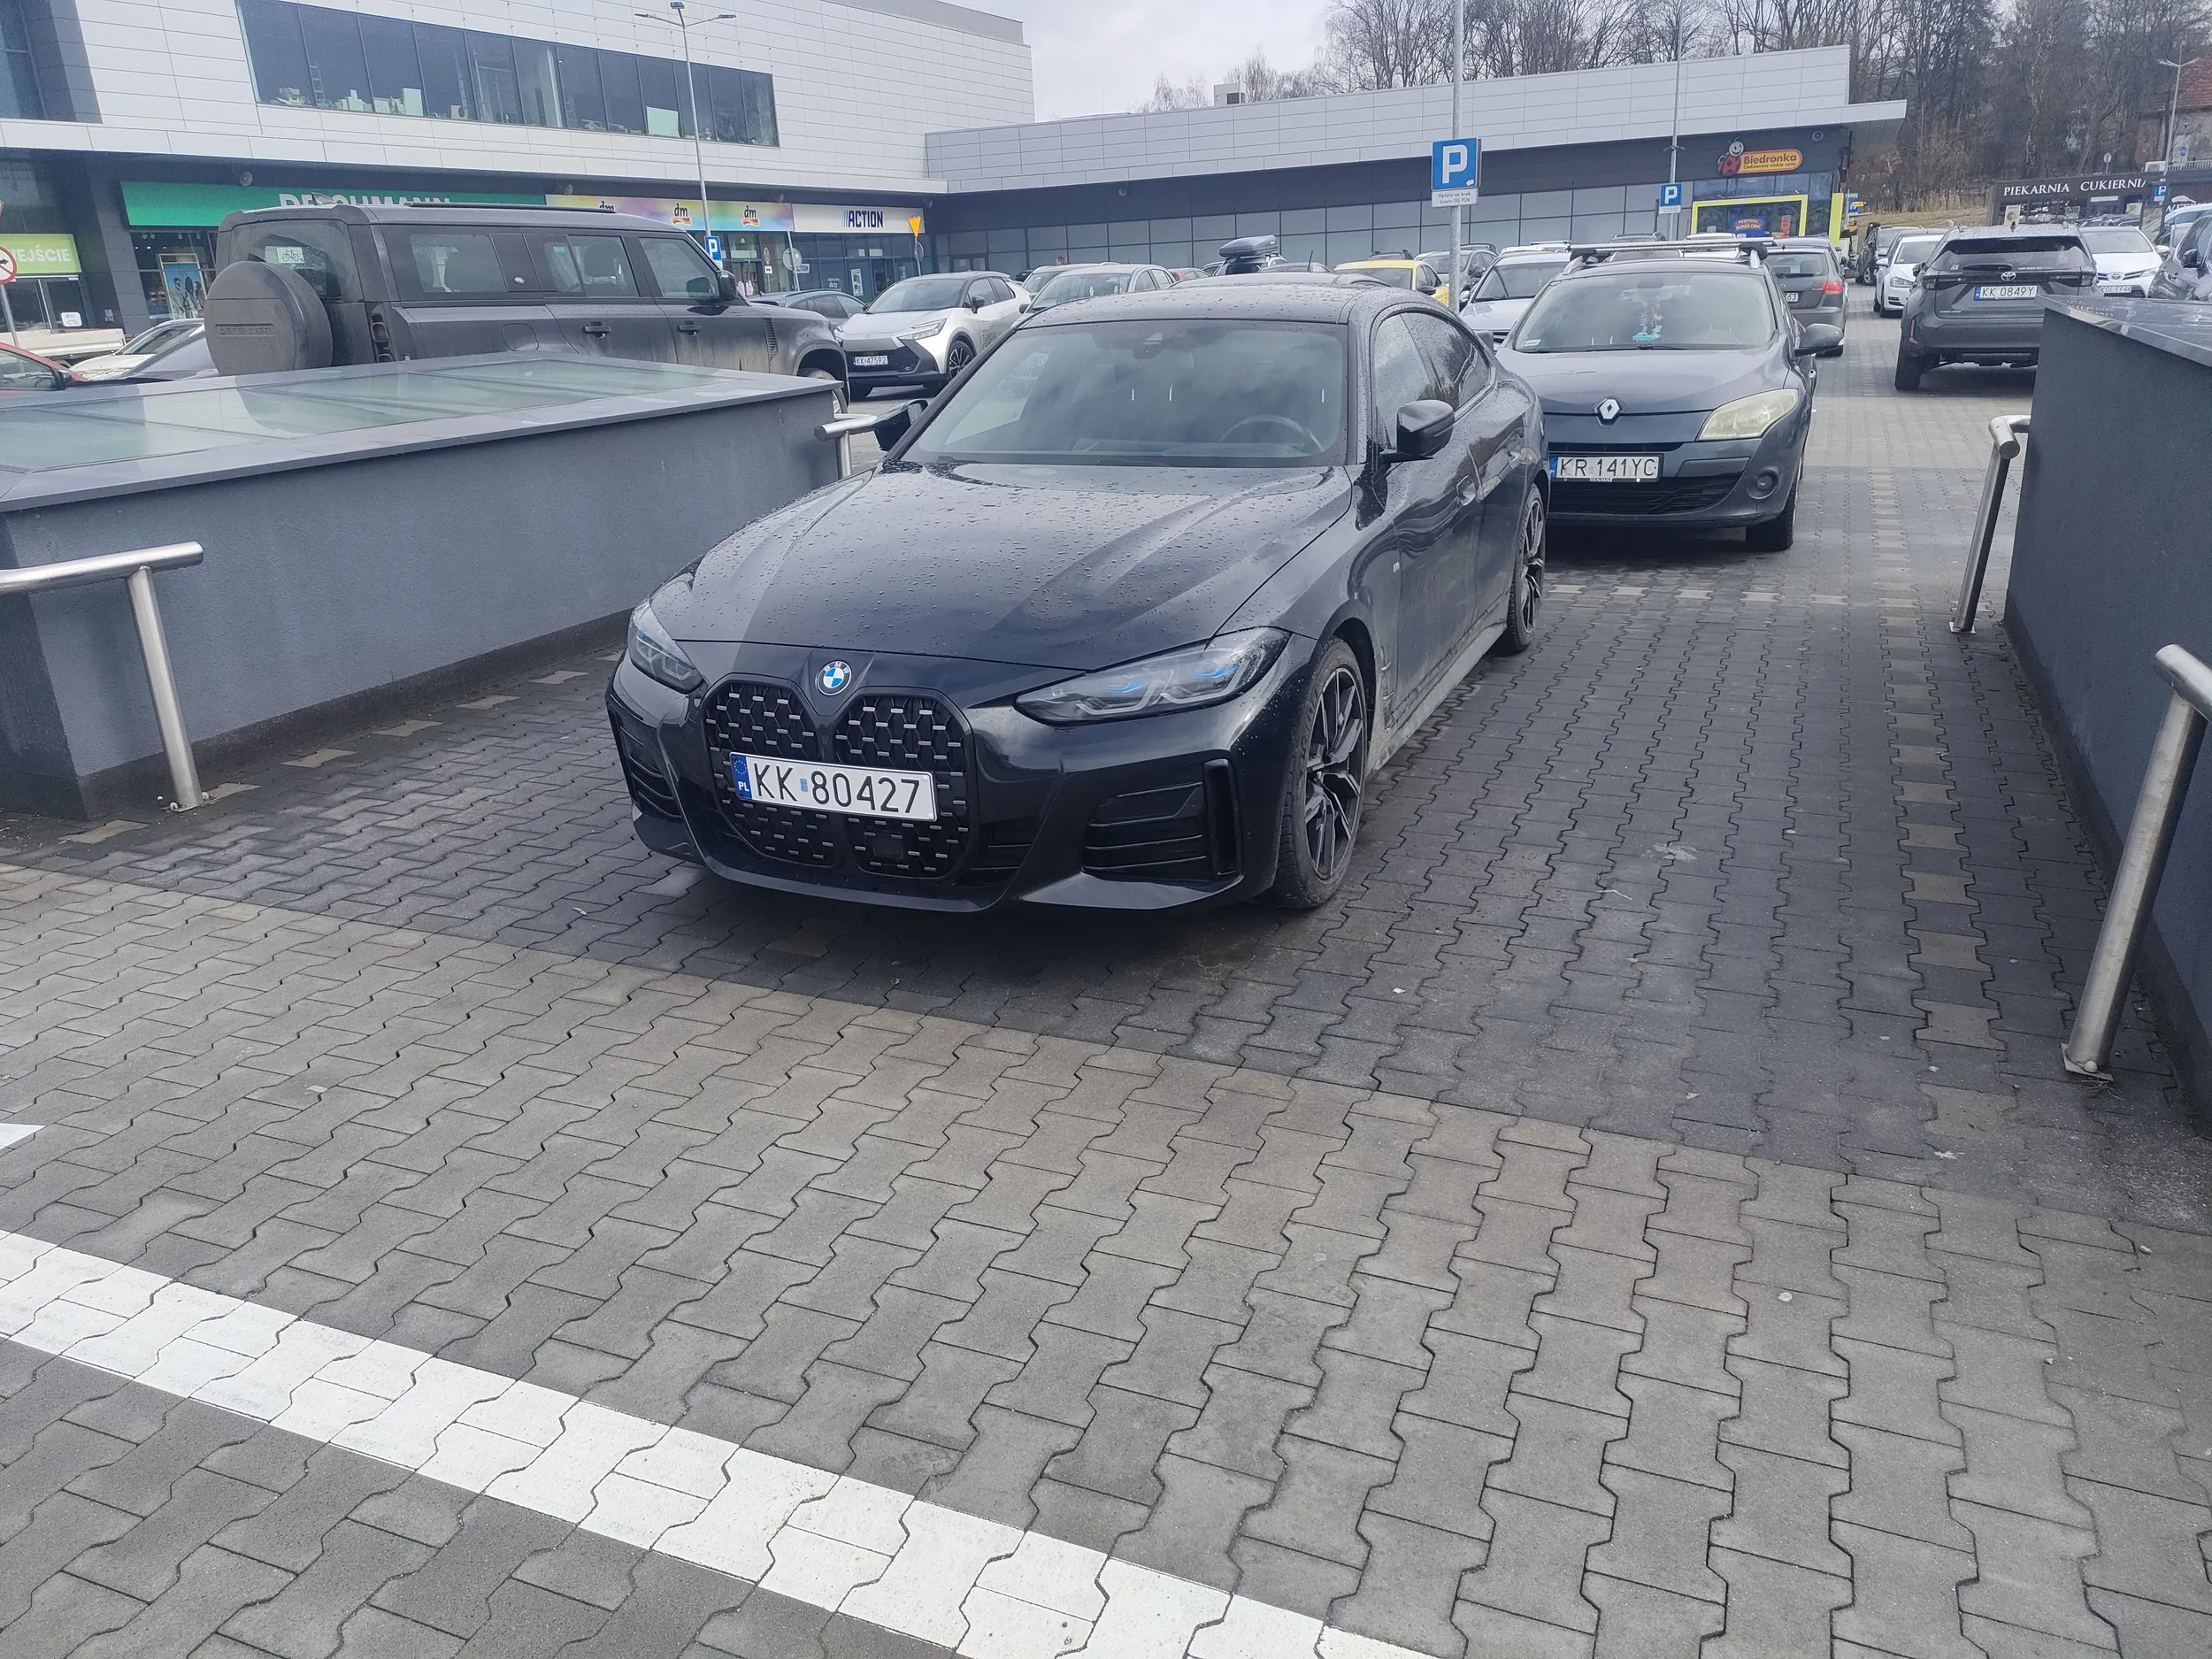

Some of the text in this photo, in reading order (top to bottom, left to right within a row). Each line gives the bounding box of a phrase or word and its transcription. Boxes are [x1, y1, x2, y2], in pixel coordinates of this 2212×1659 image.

[1442, 144, 1467, 184] P
[1744, 153, 1796, 165] Biedronka
[1664, 186, 1678, 204] P
[2003, 183, 2070, 196] PIEKARNIA
[674, 204, 688, 218] dm
[744, 205, 757, 219] dm
[849, 210, 883, 227] ACTION
[12, 244, 71, 262] EJŚCIE
[709, 239, 718, 257] P
[1981, 286, 2034, 296] KK 0849Y
[1560, 458, 1587, 476] KR
[1596, 458, 1655, 476] 141YC
[824, 662, 850, 673] BMW
[737, 763, 919, 813] PL KK 80427
